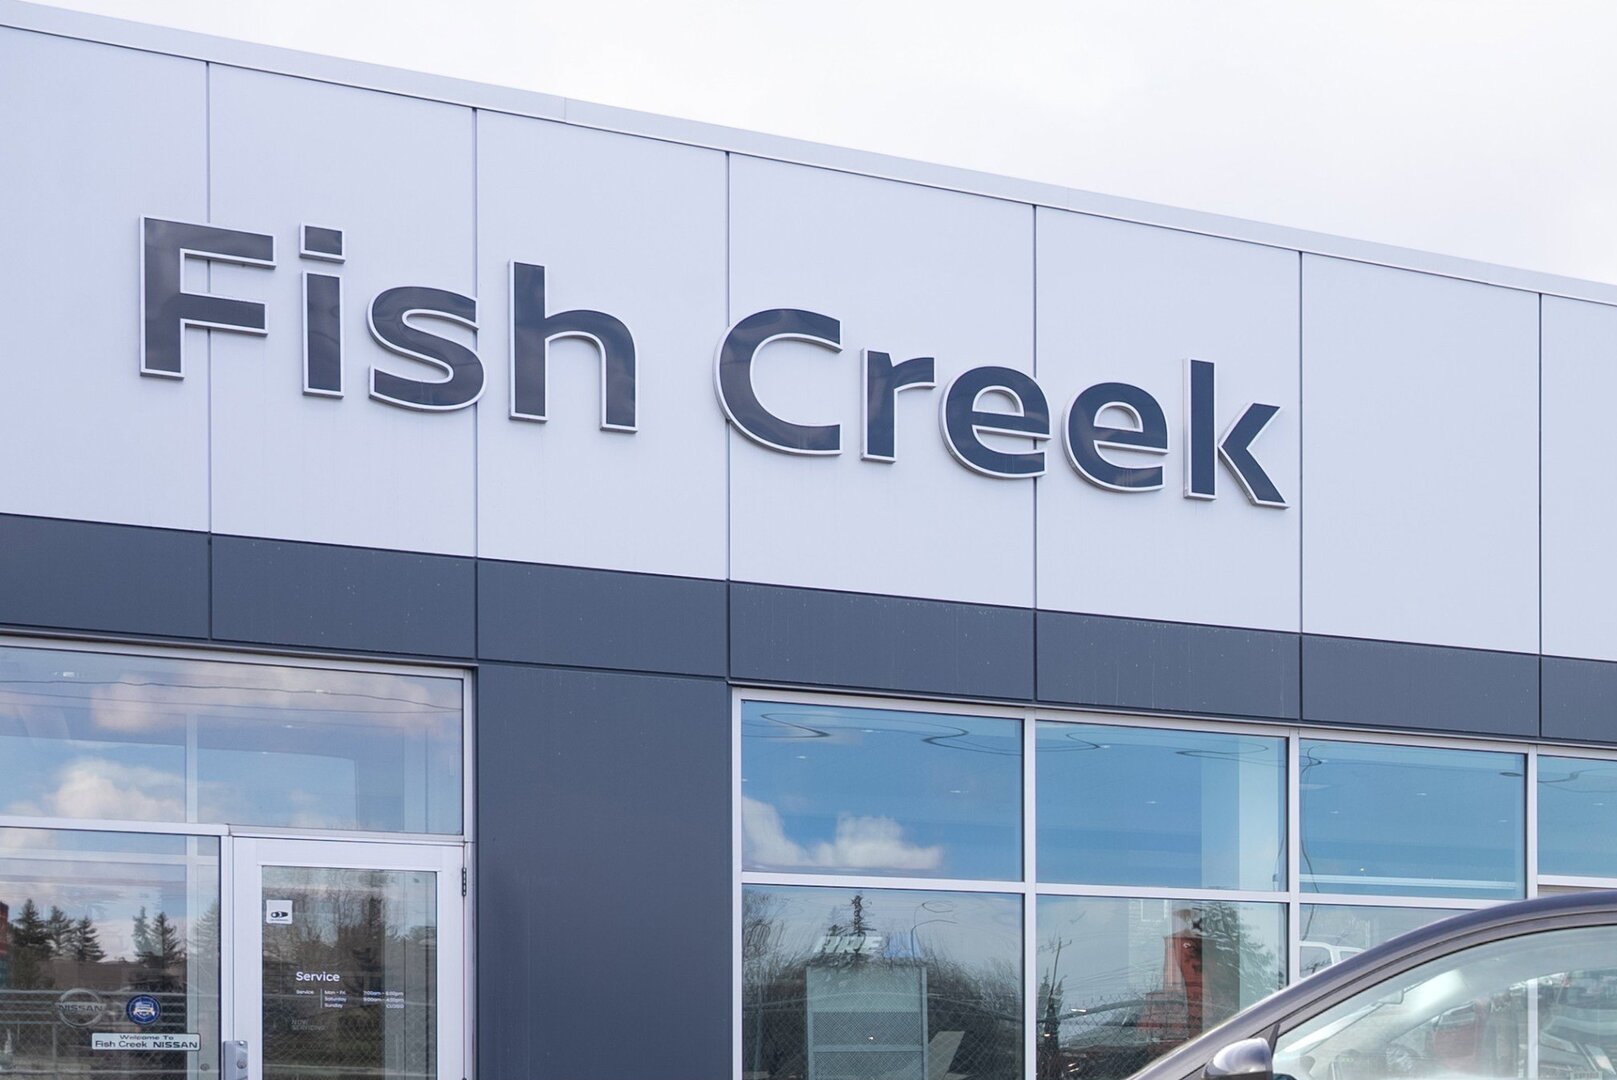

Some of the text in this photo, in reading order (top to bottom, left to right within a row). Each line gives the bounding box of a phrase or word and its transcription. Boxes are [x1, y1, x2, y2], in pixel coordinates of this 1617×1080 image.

[140, 214, 1290, 512] Fish Creek
[296, 971, 340, 982] Service
[58, 1004, 103, 1012] NISSAN
[153, 1041, 198, 1049] NISSAN
